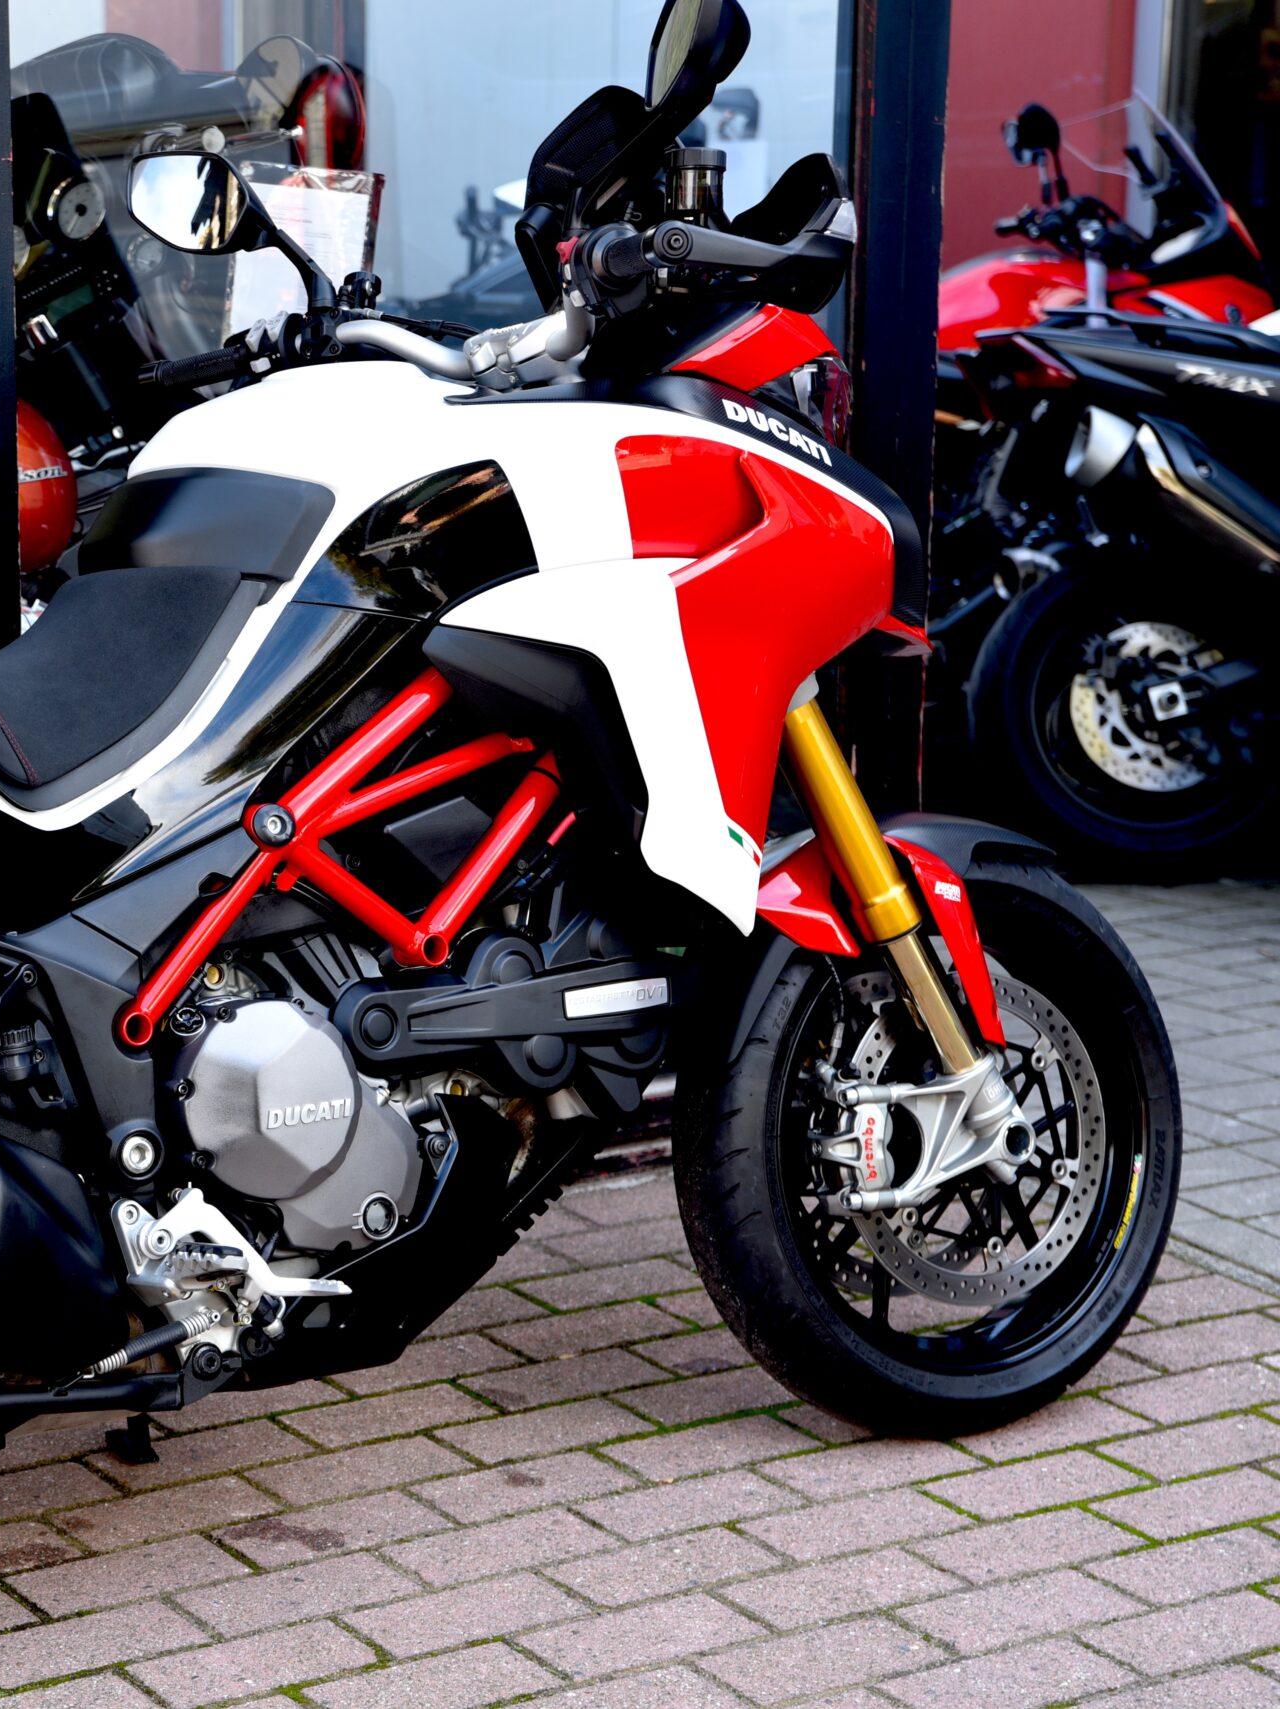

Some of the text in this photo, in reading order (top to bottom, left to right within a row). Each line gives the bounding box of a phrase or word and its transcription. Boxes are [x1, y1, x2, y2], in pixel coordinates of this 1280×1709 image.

[722, 399, 833, 467] DUCATI
[636, 985, 667, 1002] DVT
[266, 1098, 352, 1130] DUCATI
[862, 1117, 877, 1183] brembo
